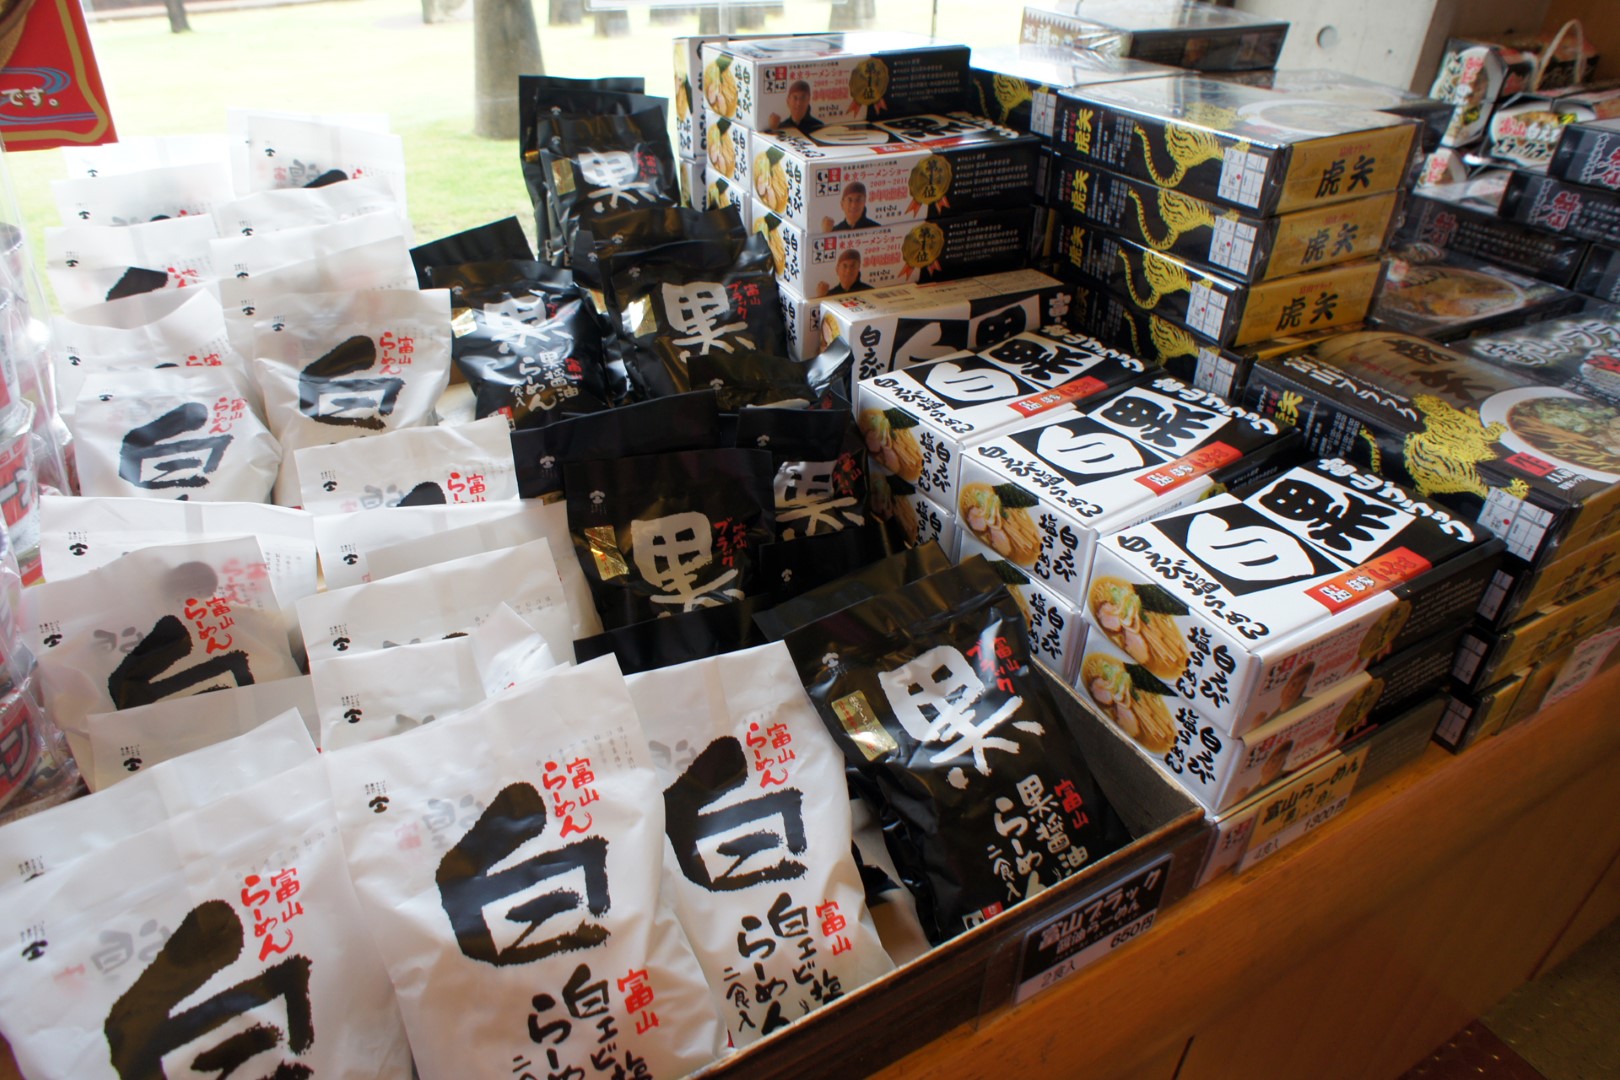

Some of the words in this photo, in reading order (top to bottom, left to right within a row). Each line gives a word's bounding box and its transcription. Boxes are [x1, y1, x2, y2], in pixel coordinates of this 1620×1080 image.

[578, 150, 657, 214] 黒
[793, 162, 803, 215] 白えび
[397, 336, 414, 366] 富山
[661, 281, 756, 364] 黒
[1043, 324, 1145, 373] 富山ブラック
[299, 334, 407, 431] 白
[379, 331, 403, 376] らーめん
[989, 338, 1092, 380] 黒
[230, 397, 249, 421] 富山
[519, 356, 558, 412] らーめん
[874, 377, 975, 434] 白えび塩らーめん
[1151, 377, 1279, 435] 富山ブラック
[208, 396, 233, 435] らーめん
[1100, 395, 1217, 447] 黒
[118, 401, 235, 490] 白
[932, 440, 952, 494] 白えび
[978, 444, 1104, 518] 白えび塩らーめん
[1317, 456, 1476, 543] 富山ブラック
[713, 518, 735, 568] ブラック
[1259, 477, 1397, 553] 黒
[631, 510, 746, 618] 黒
[1053, 525, 1078, 582] 白えび
[204, 596, 236, 631] 富山
[1117, 533, 1270, 640] 白えび塩らーめん
[183, 597, 233, 654] らーめん
[992, 636, 1021, 673] 富山
[1042, 606, 1065, 660] 白えび
[966, 644, 1017, 694] ブラック
[1201, 644, 1238, 709] 白えび
[766, 722, 797, 765] 富山
[877, 644, 1046, 790] 黒
[566, 756, 600, 808] 富山
[745, 722, 789, 790] らーめん
[1188, 726, 1223, 784] 白えび
[541, 761, 593, 839] らーめん
[662, 734, 809, 893] 白
[1015, 773, 1090, 878] 黒醤油
[1052, 778, 1090, 831] 富山
[269, 867, 305, 924] 富山
[434, 781, 612, 968] 白
[986, 844, 1021, 902] 二食入
[240, 875, 295, 963] らーめん
[815, 898, 853, 957] 富山
[1038, 868, 1162, 952] 富山ブラック
[1109, 913, 1155, 949] 650円
[766, 891, 846, 1006] 白エビ塩
[103, 898, 316, 1080] 白
[616, 968, 660, 1036] 富山
[723, 966, 756, 1033] 二食入
